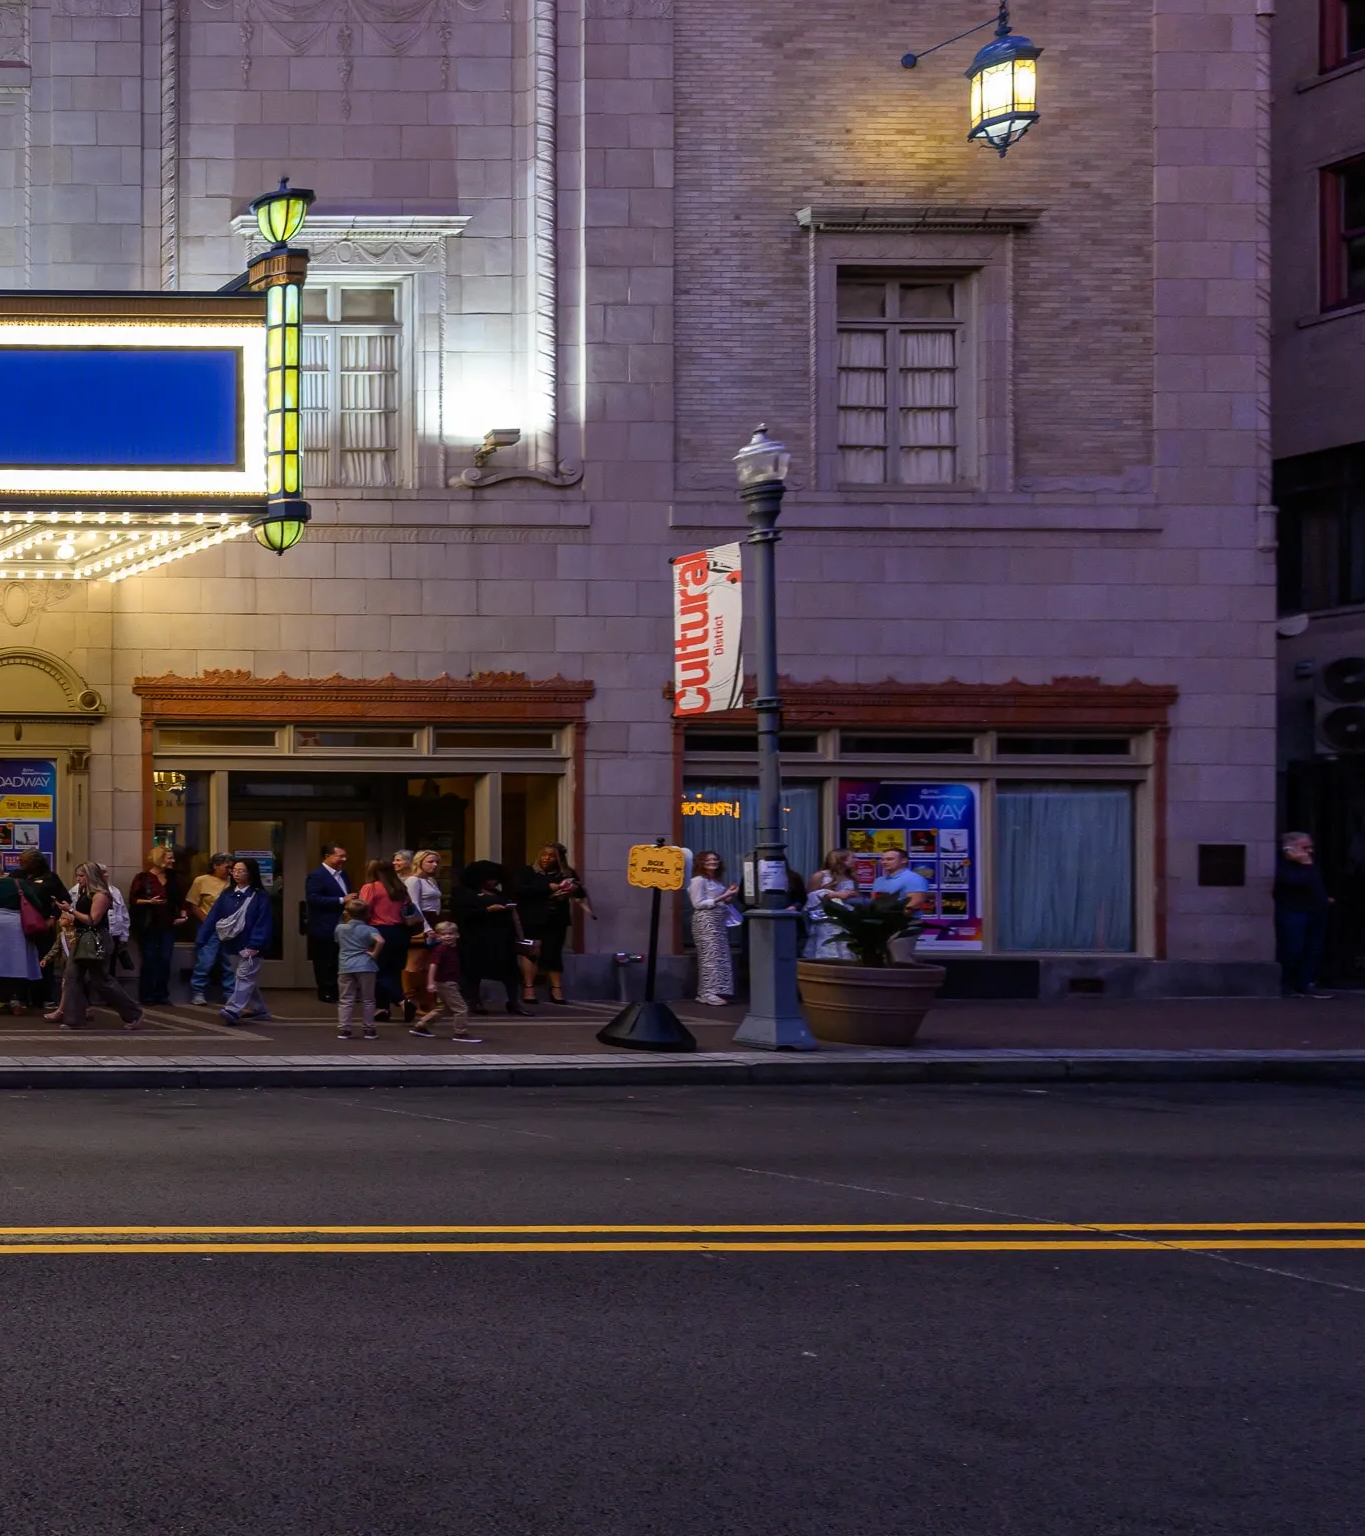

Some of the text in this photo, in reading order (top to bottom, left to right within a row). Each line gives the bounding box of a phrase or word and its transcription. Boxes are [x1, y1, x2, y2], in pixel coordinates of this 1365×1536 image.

[673, 550, 711, 716] Cultural
[713, 615, 725, 656] District
[846, 803, 967, 820] BROADWAY
[641, 866, 670, 875] OFFICE
[648, 859, 665, 867] BOX
